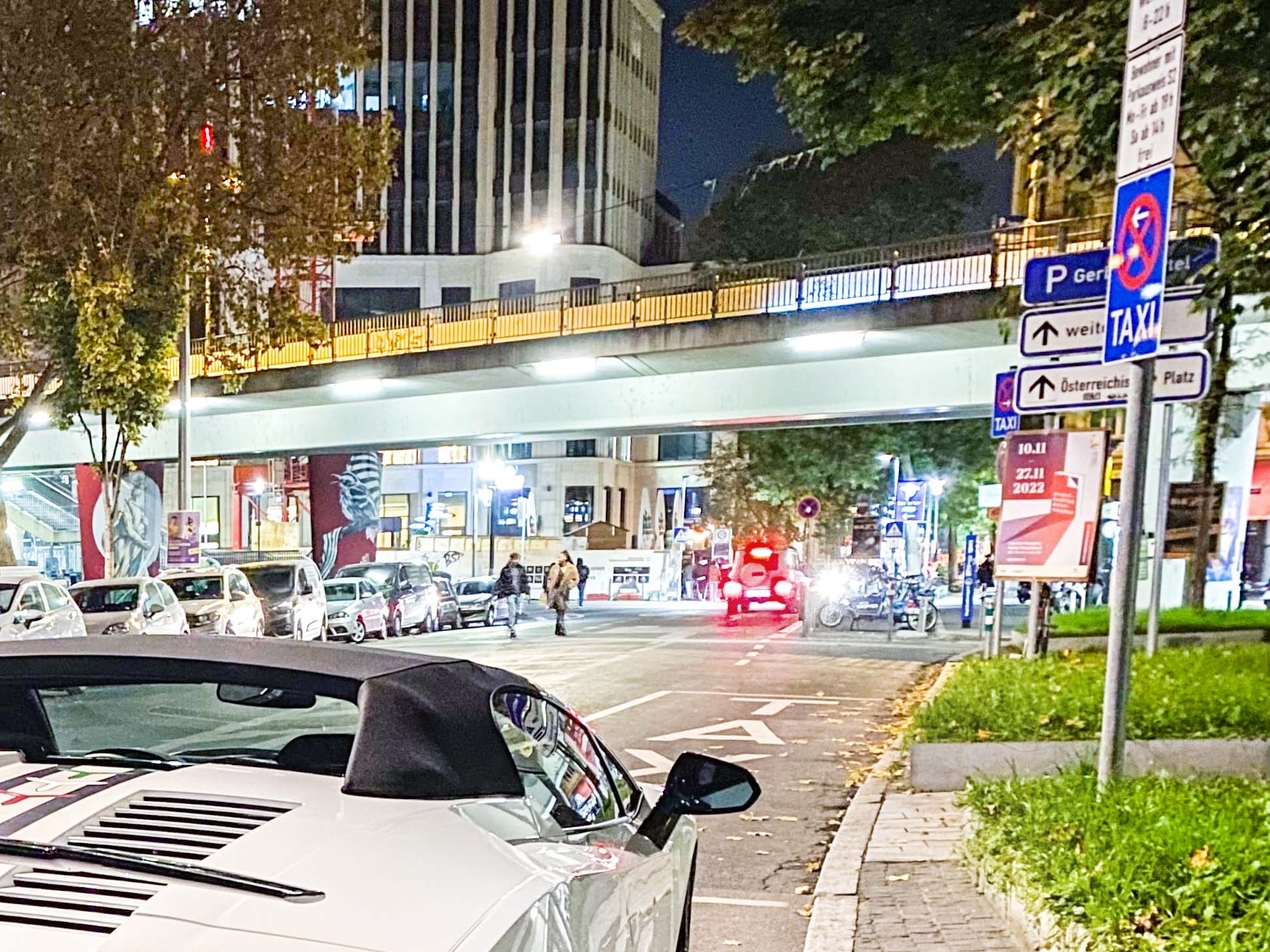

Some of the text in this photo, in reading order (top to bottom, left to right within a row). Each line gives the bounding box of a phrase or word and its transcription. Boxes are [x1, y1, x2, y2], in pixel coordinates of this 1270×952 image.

[1046, 264, 1068, 294] P
[1110, 300, 1159, 348] TAXI
[1164, 370, 1196, 385] Platz
[995, 417, 1016, 431] TAXI
[1018, 441, 1047, 457] 10.11
[1016, 466, 1045, 481] 27.11
[1013, 481, 1045, 495] 2022
